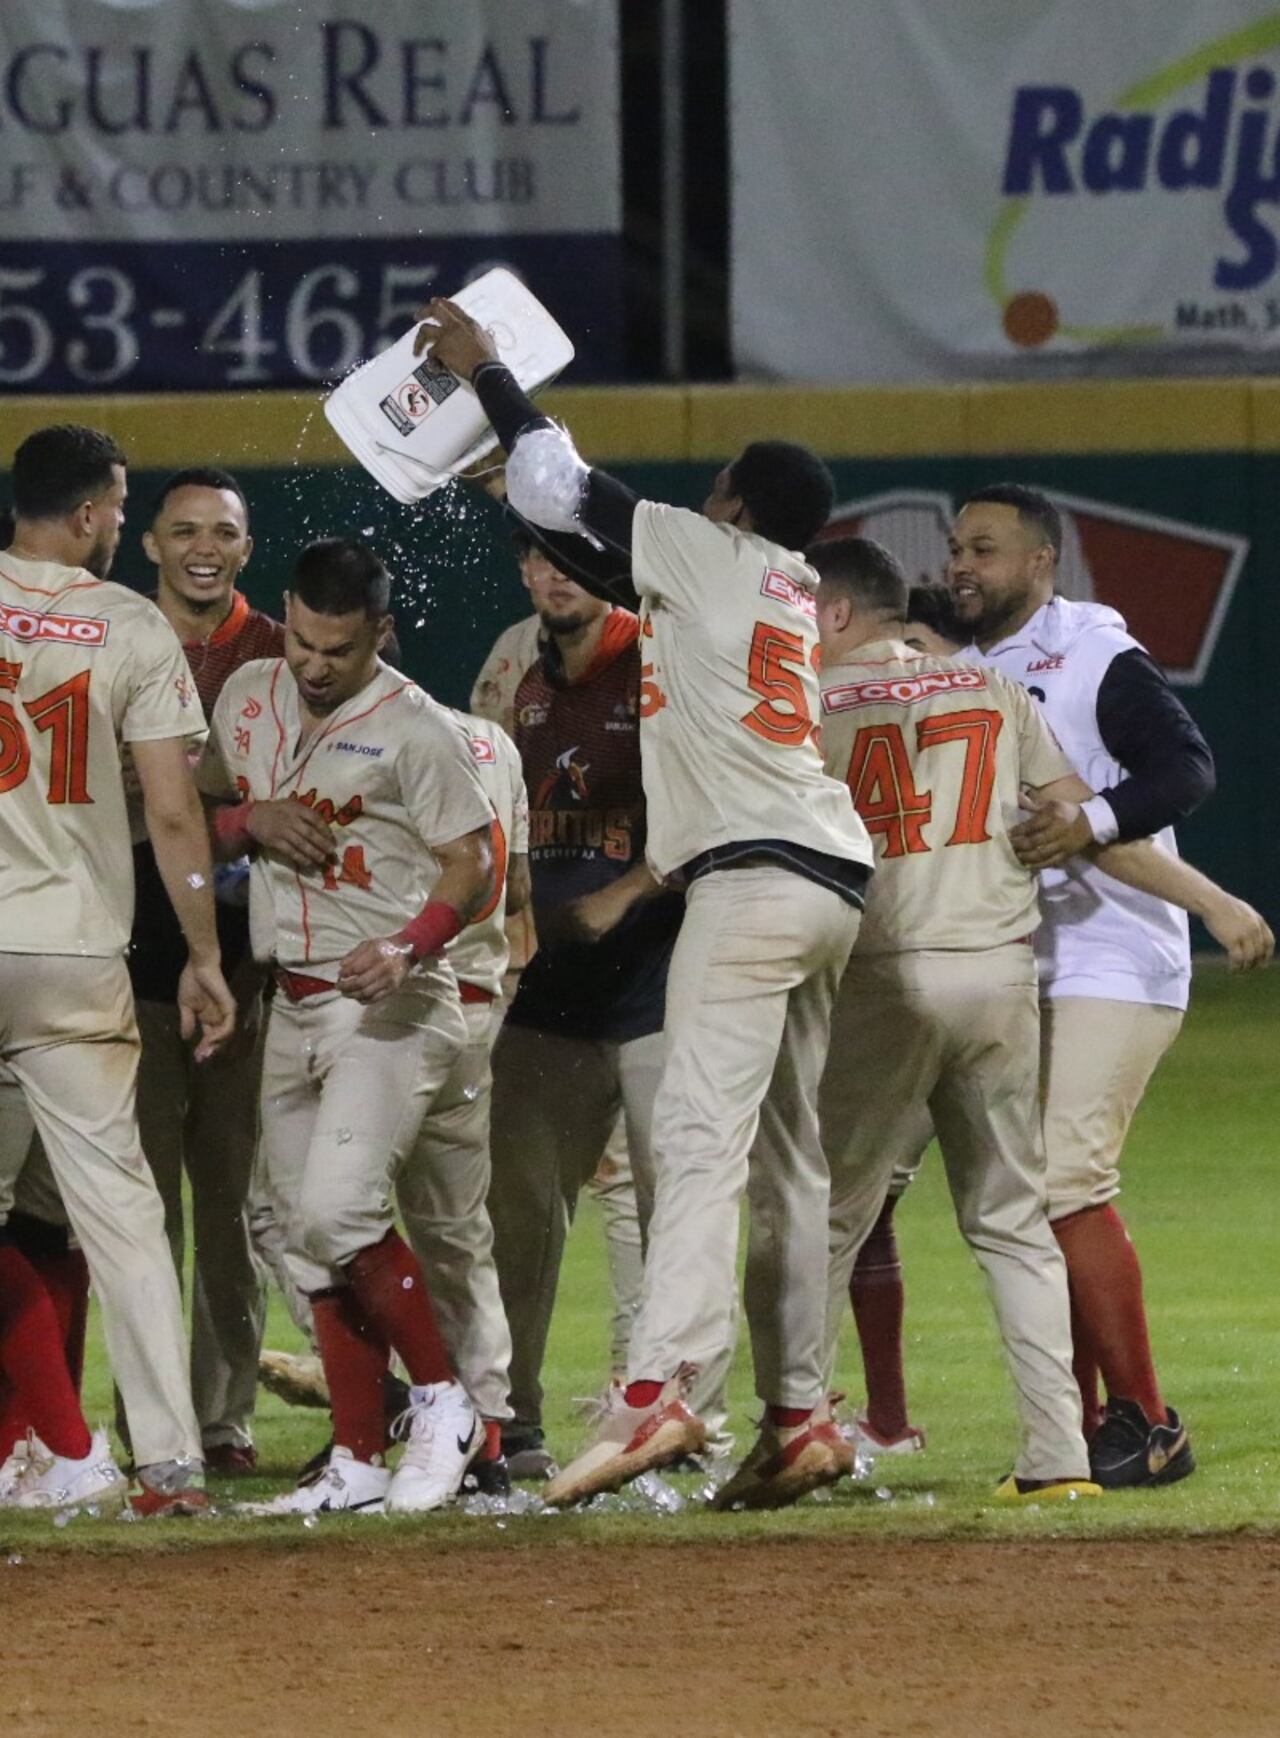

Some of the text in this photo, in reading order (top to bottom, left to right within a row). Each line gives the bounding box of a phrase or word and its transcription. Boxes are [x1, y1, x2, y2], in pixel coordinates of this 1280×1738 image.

[320, 18, 582, 130] REAL
[53, 167, 94, 209] &
[108, 160, 382, 211] COUNTRY
[394, 157, 536, 206] CLUB
[826, 672, 982, 708] ECONO
[844, 708, 1004, 859] 47
